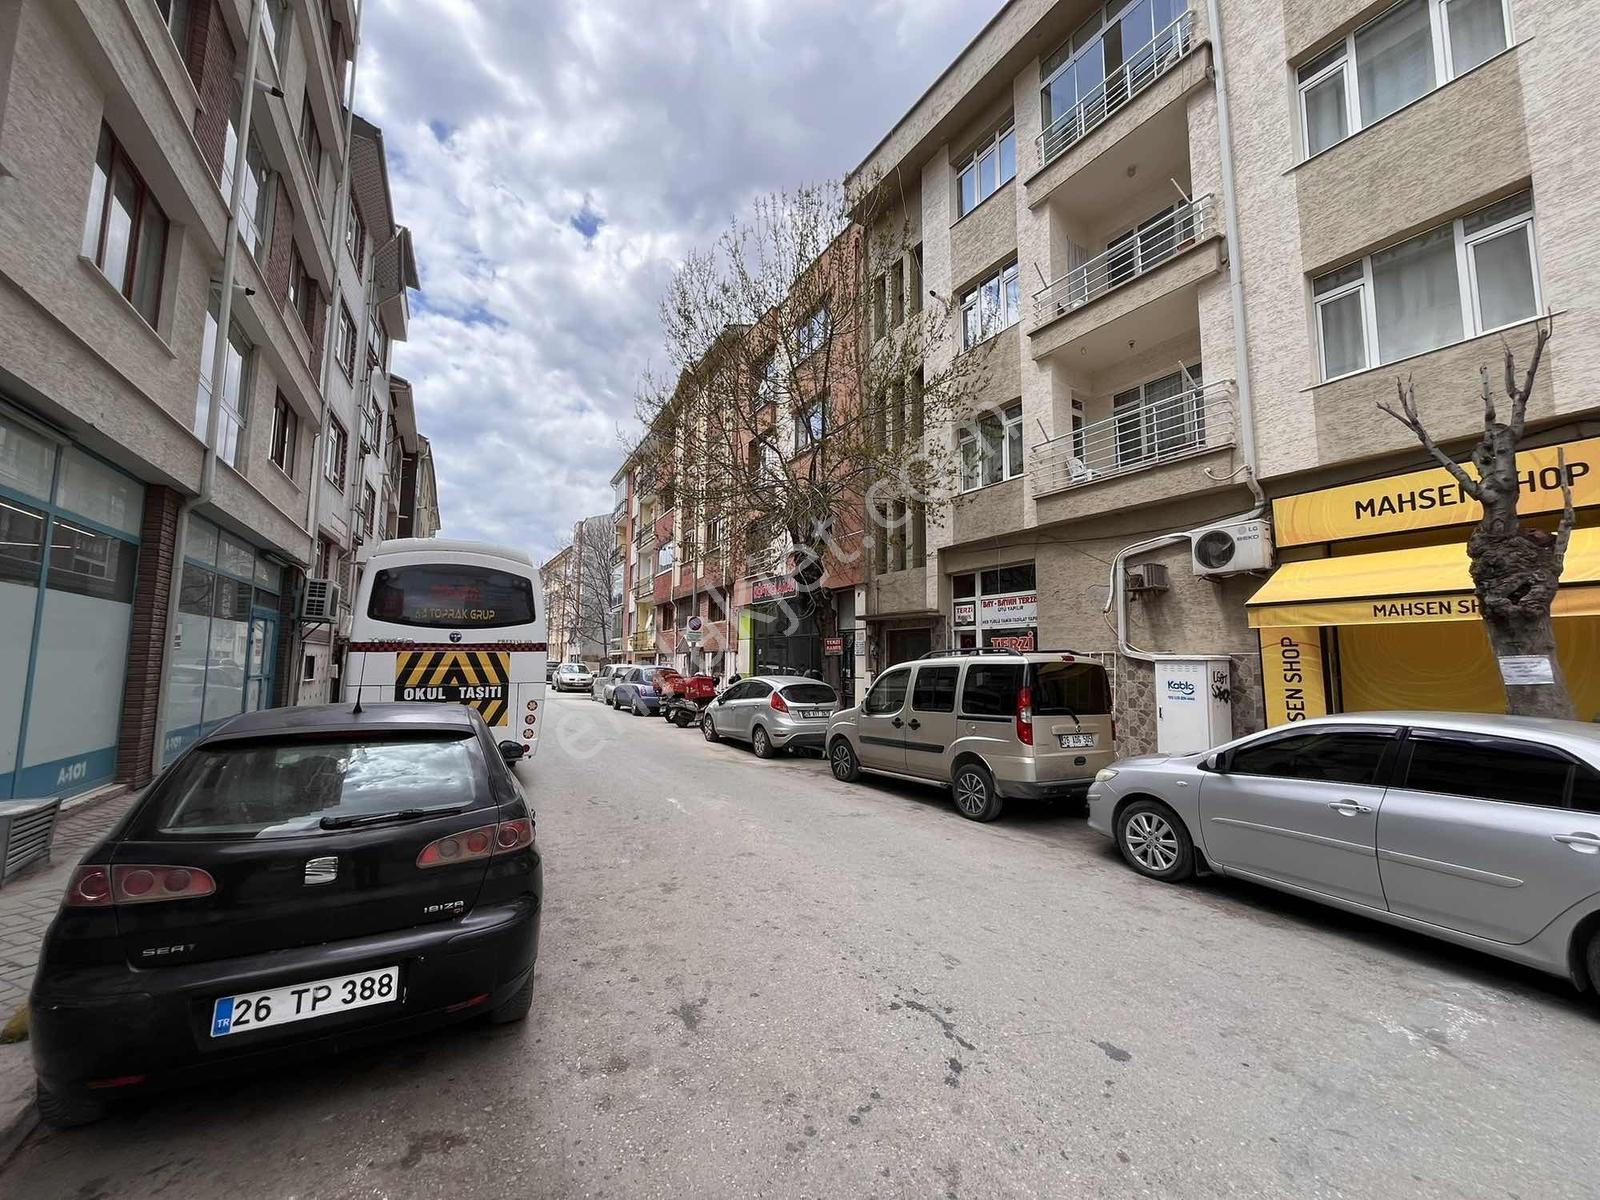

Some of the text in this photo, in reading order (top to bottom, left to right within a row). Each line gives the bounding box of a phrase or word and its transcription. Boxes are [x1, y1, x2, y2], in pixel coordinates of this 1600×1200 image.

[1516, 461, 1590, 493] HOP
[470, 609, 495, 620] GRUP
[1373, 599, 1481, 617] MAHSEN SH
[1280, 636, 1306, 723] SEN SHOP
[403, 685, 502, 701] OKUL TAŞITI
[424, 900, 465, 913] IBIZA
[232, 973, 393, 1027] 26 TP 388
[217, 1018, 230, 1028] TR
